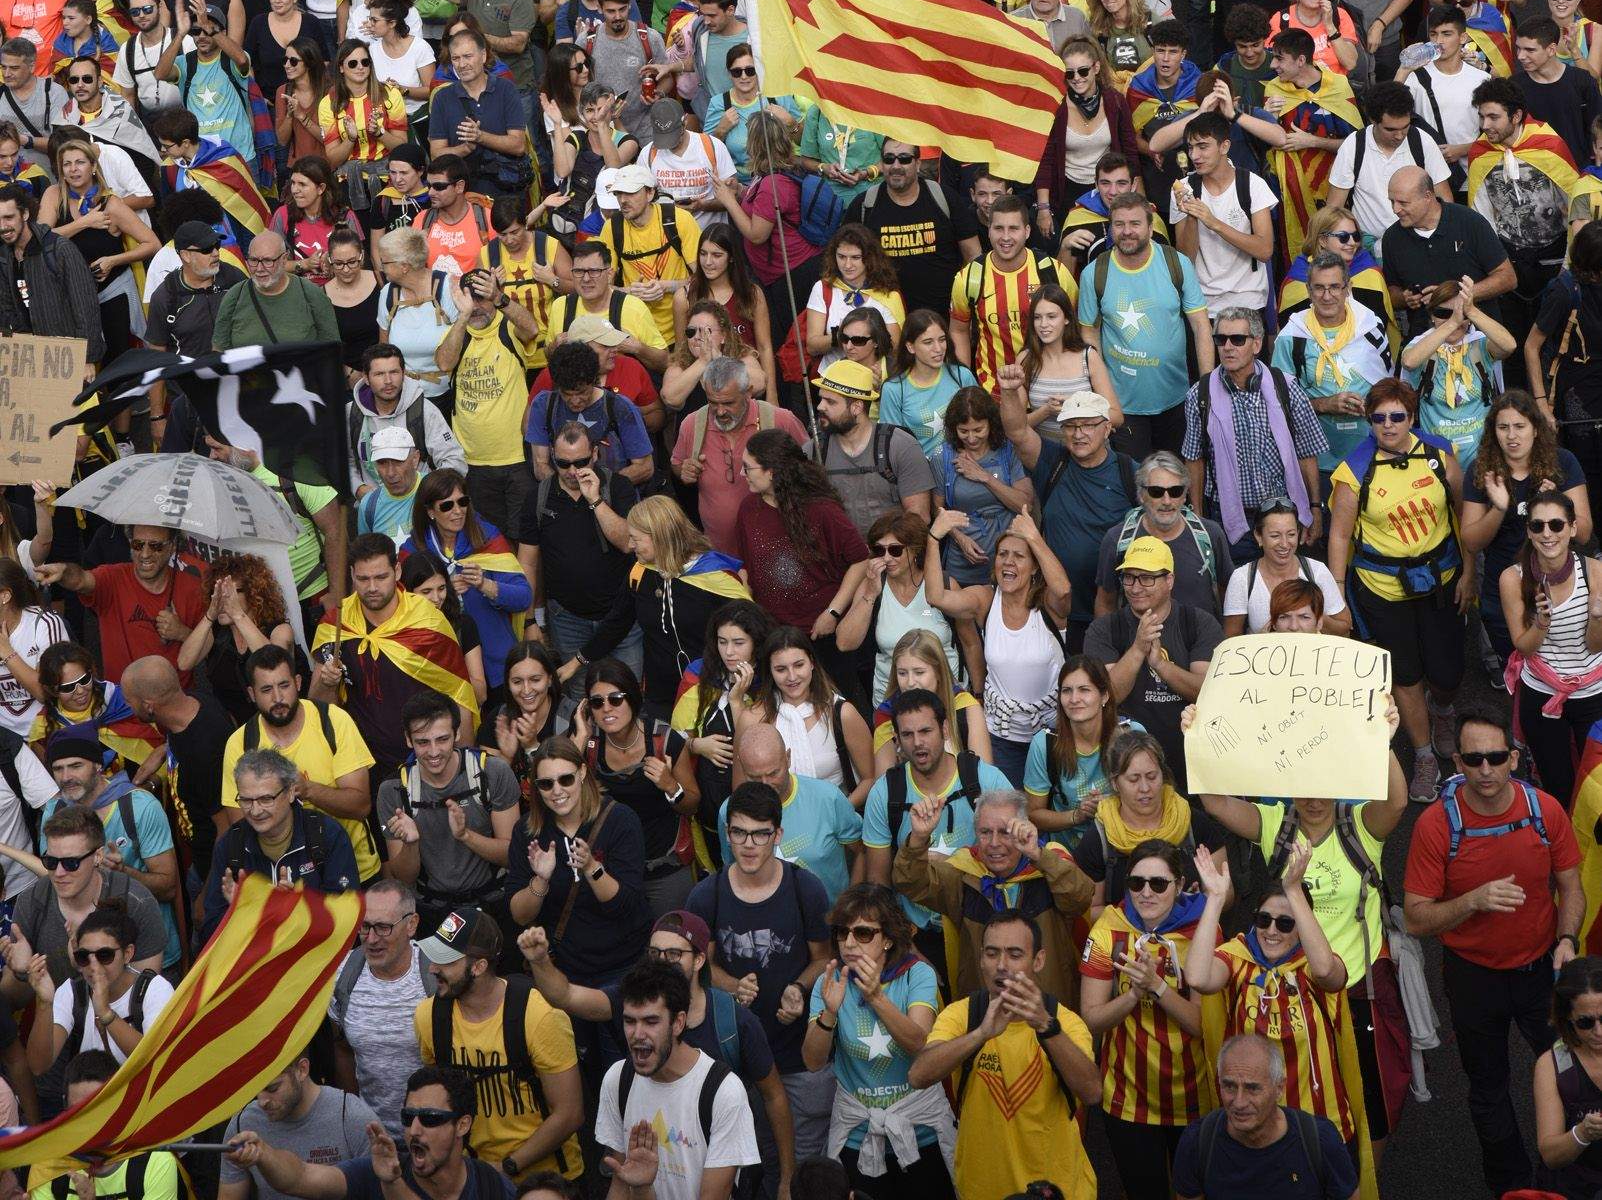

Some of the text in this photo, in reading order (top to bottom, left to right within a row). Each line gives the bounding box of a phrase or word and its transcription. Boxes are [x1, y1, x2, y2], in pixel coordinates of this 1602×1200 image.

[881, 230, 924, 249] CATALÀ
[42, 350, 76, 381] NO
[460, 377, 502, 392] POLITICAL
[1239, 686, 1375, 721] AL POBLE!
